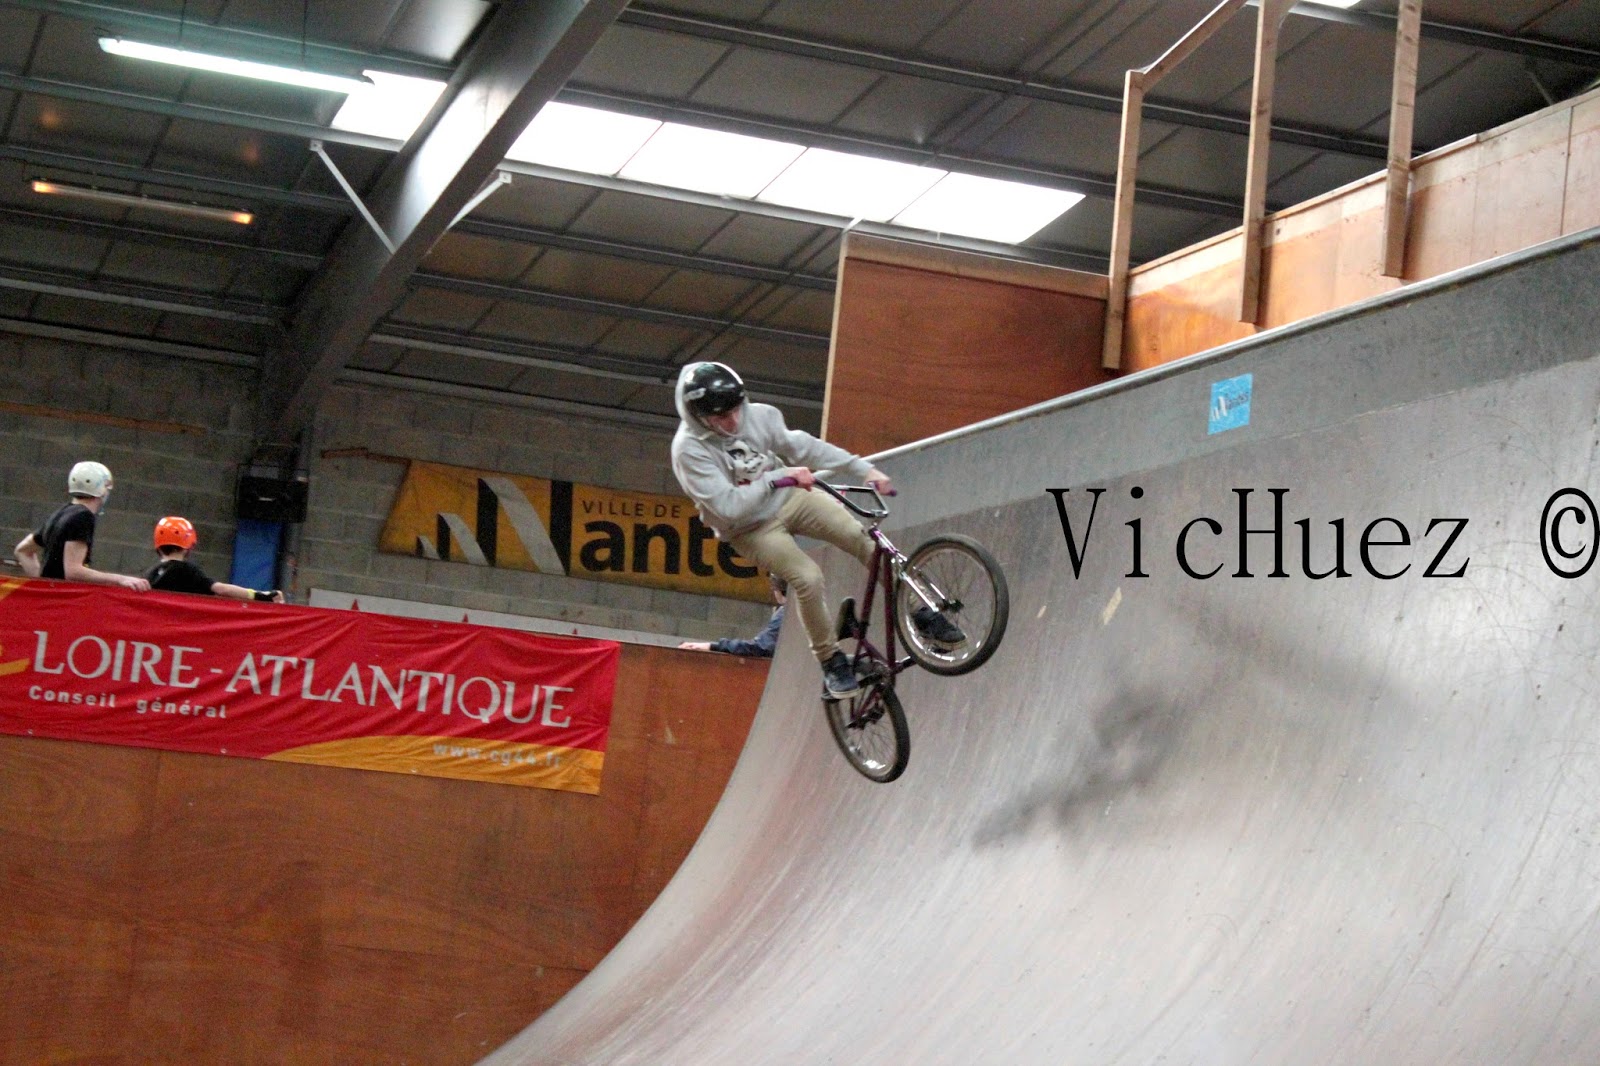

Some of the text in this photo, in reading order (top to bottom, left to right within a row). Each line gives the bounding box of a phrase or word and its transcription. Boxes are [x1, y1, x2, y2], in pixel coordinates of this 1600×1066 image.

[582, 499, 681, 519] VILLE DE
[28, 684, 227, 719] Conseil général
